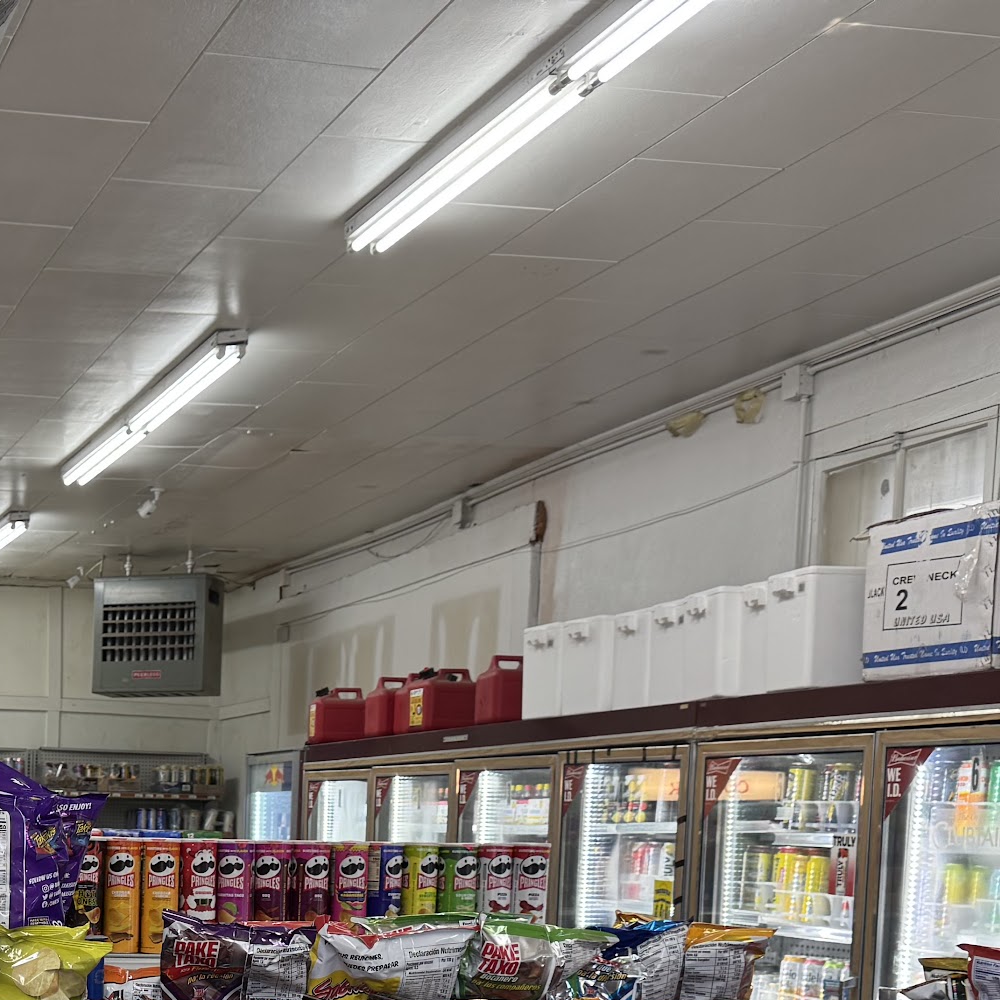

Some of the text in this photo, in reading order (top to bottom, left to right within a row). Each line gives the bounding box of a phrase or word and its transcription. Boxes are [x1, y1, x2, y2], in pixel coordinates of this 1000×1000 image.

[895, 589, 908, 611] 2
[894, 614, 950, 627] UNITED USA
[887, 768, 901, 782] WE
[972, 757, 979, 790] 6
[887, 784, 901, 797] I.D.
[69, 802, 91, 810] ENJOY!
[833, 836, 856, 847] TRULY
[108, 874, 134, 888] PRINGLES
[149, 874, 175, 888] PRINGLES
[191, 875, 215, 887] PRINGLES
[218, 876, 244, 889] PRINGLES
[255, 876, 280, 889] PRINGLES
[304, 877, 328, 889] PRINGLES
[338, 877, 365, 889] PRINGLES
[488, 877, 511, 889] PRINGLES
[519, 877, 546, 889] PRINGLES
[175, 942, 218, 957] PAKE
[482, 943, 520, 960] PAKE
[478, 959, 520, 976] TAXO
